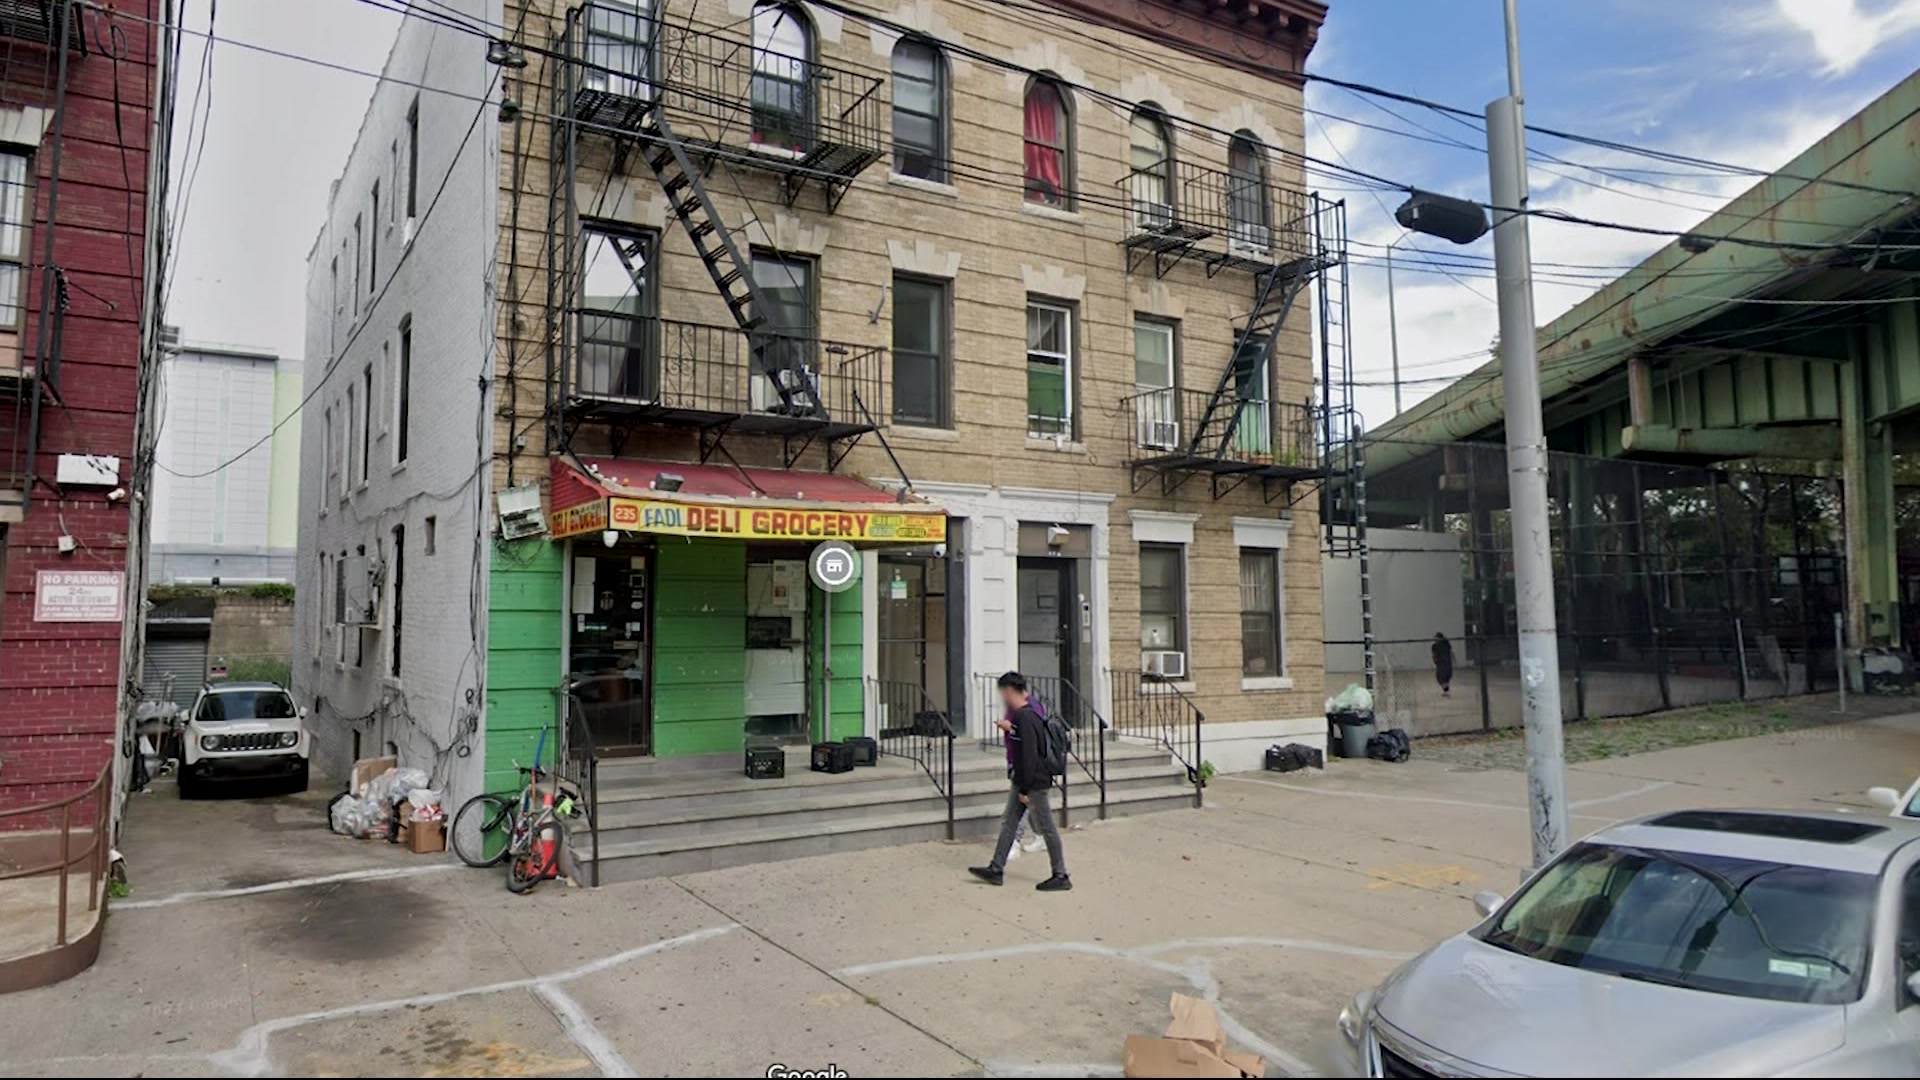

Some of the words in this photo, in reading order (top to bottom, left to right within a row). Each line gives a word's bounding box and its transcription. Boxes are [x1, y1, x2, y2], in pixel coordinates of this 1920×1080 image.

[552, 511, 568, 536] DELI
[645, 508, 682, 527] FADI
[687, 507, 740, 533] DELI
[752, 511, 868, 537] GROCERY
[43, 575, 61, 585] NO
[64, 575, 119, 585] PARKING
